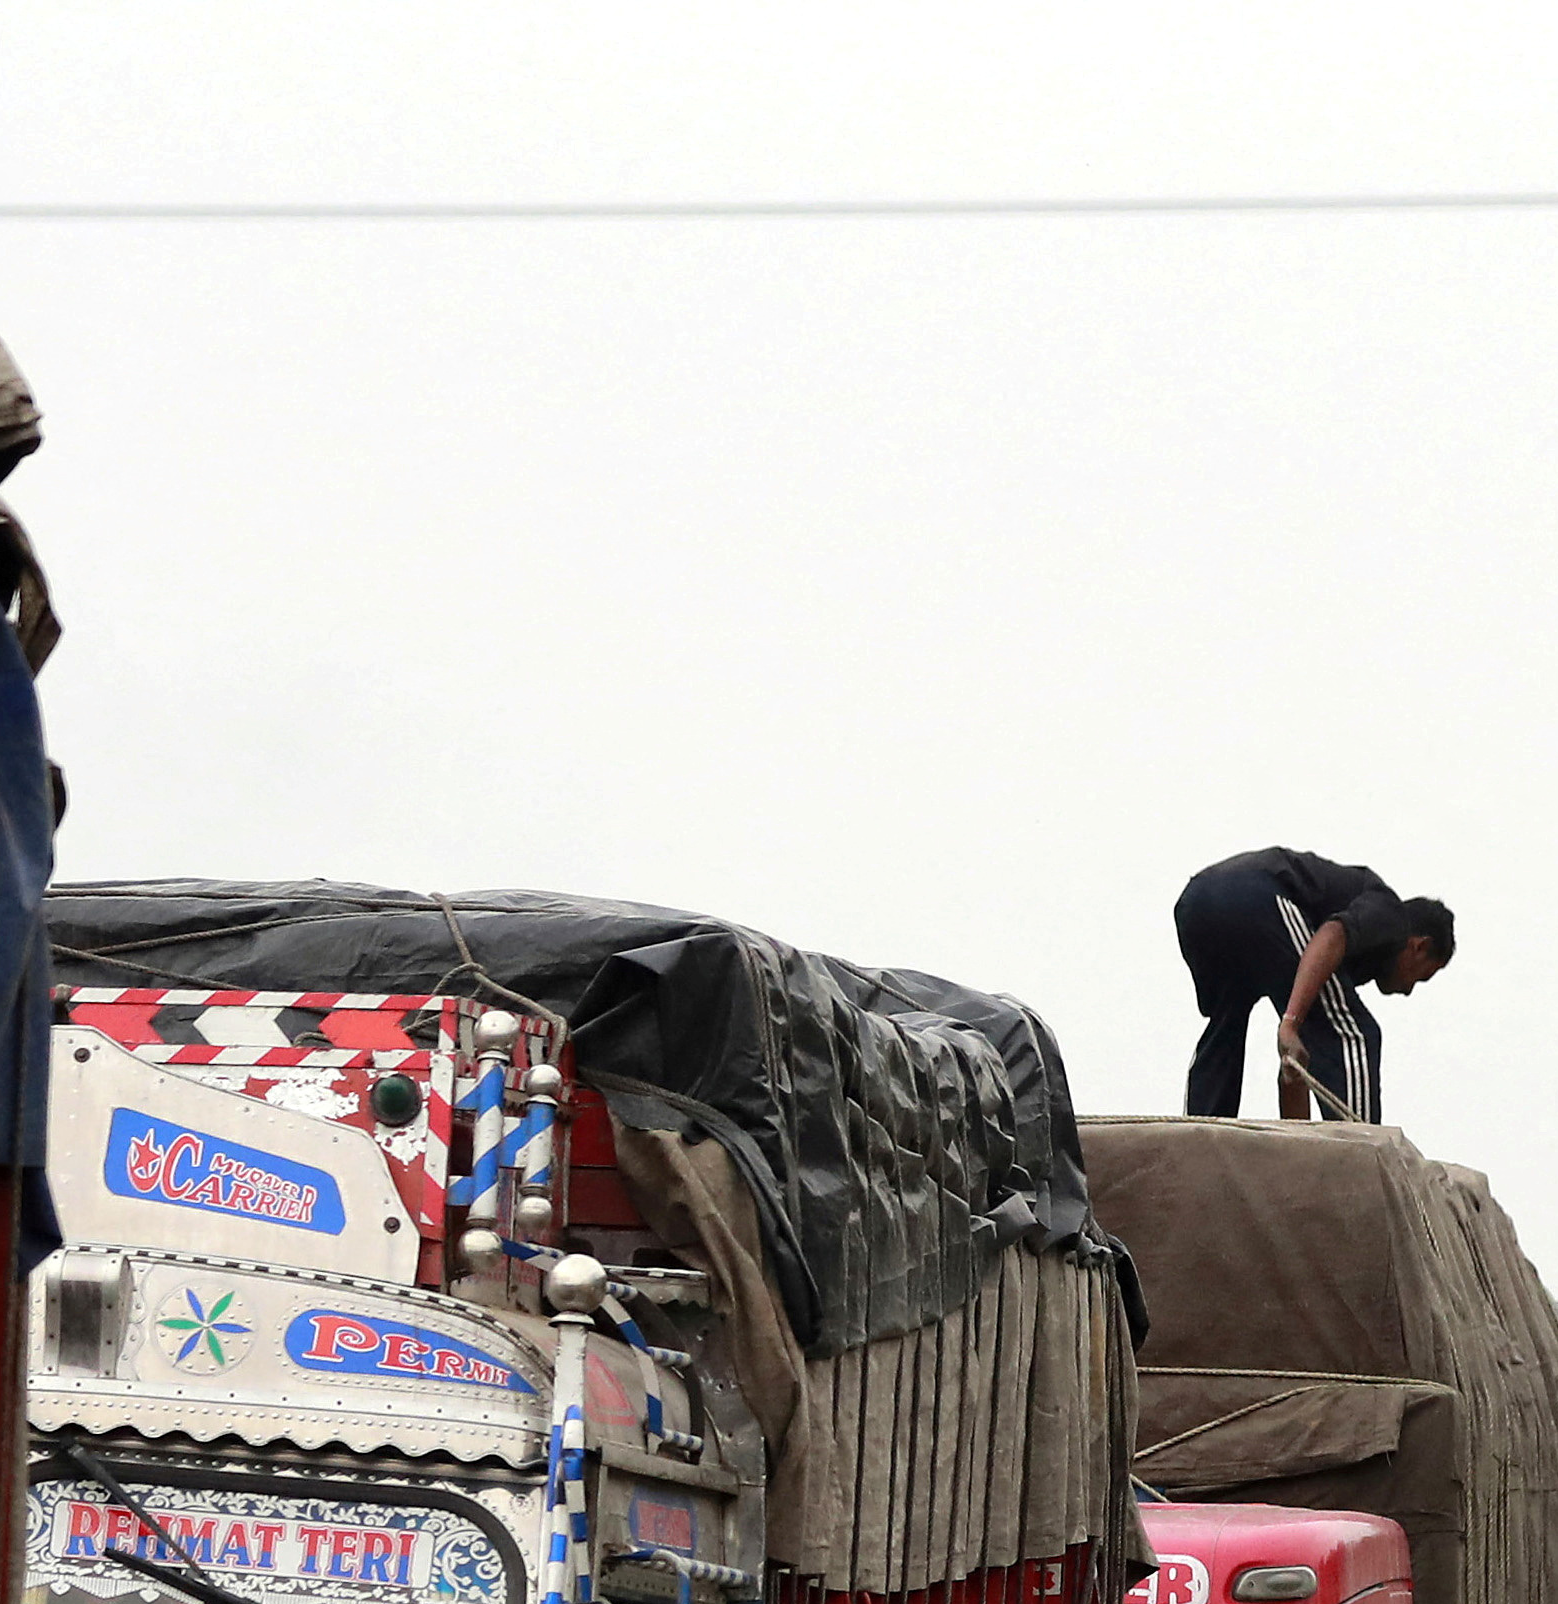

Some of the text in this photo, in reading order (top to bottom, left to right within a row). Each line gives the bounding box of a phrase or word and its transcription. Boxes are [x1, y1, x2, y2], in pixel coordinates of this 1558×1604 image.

[161, 1132, 318, 1224] CARRIER
[301, 1315, 513, 1387] PERMIT
[62, 1500, 419, 1588] REHMAT TERI
